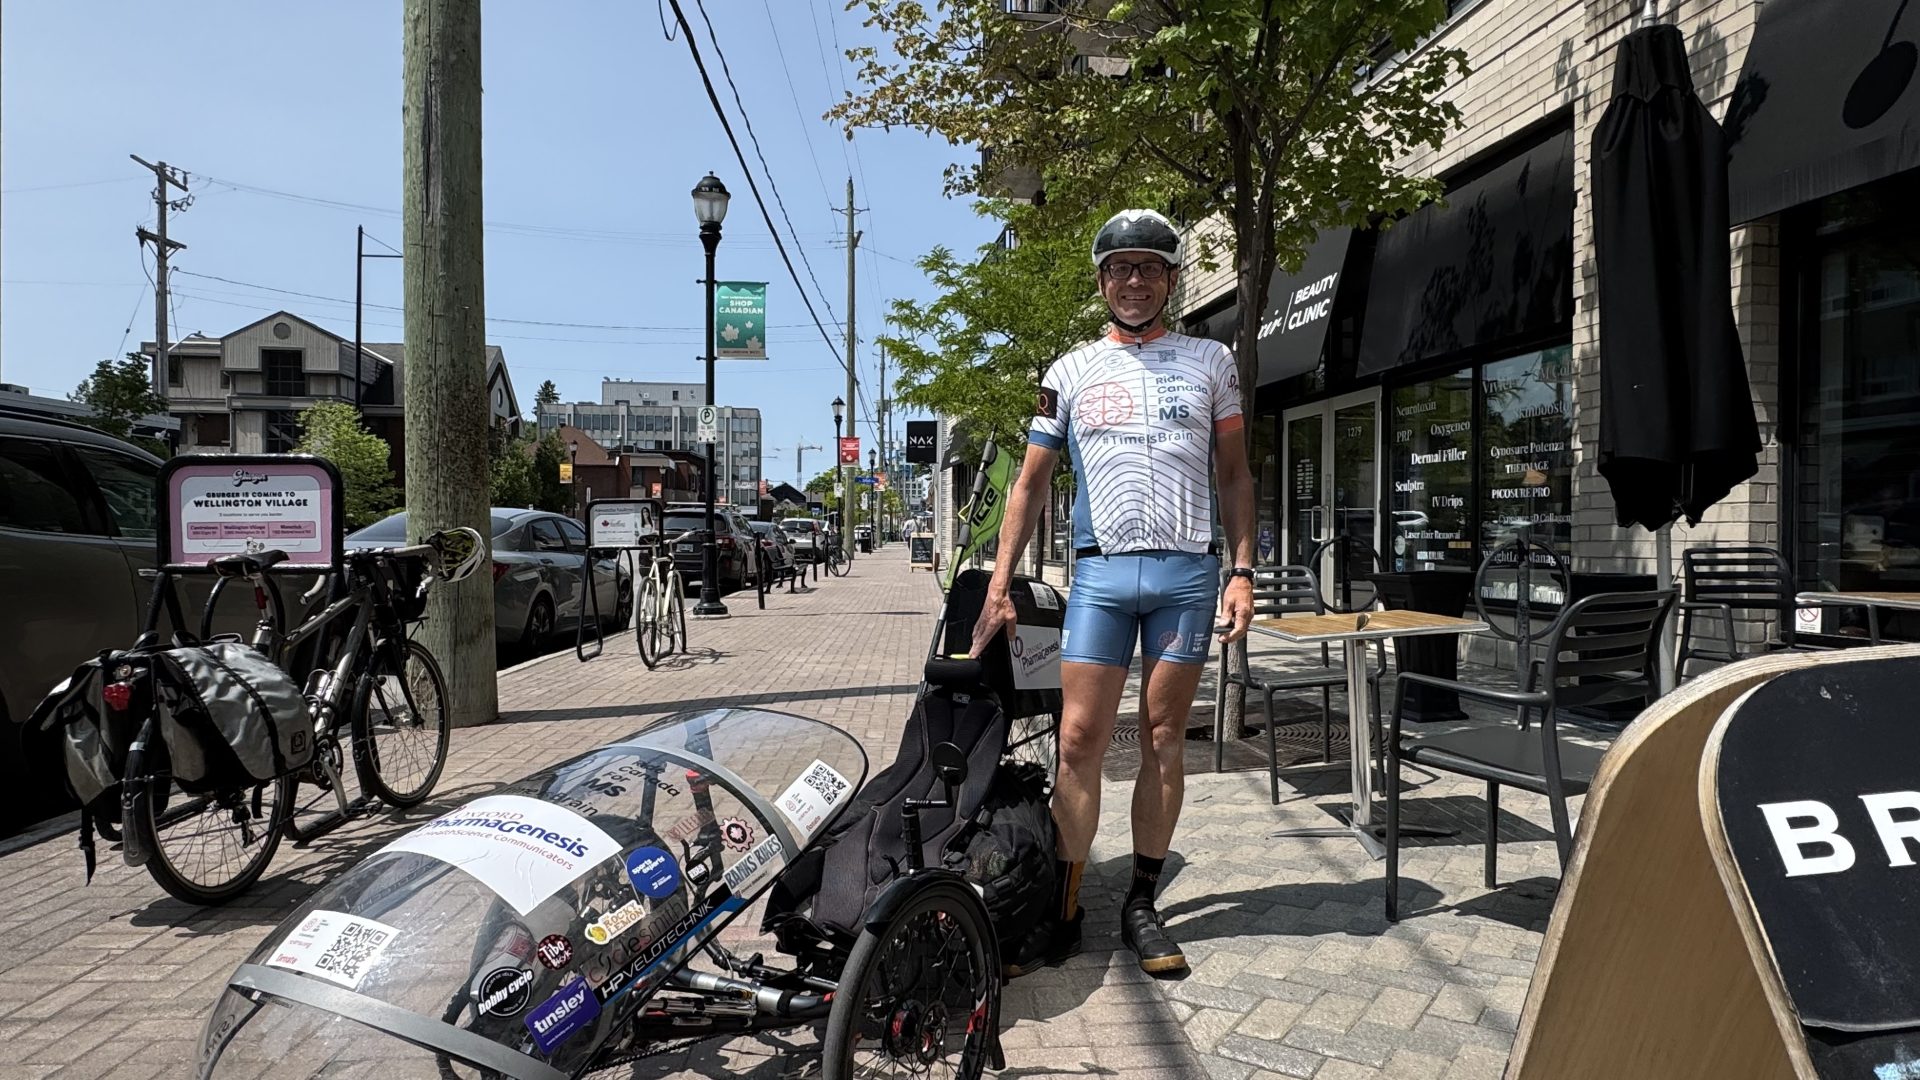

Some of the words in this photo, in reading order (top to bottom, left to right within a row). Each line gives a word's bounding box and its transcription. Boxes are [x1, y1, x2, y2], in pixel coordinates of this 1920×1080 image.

[1294, 272, 1338, 304] BEAUTY
[1288, 298, 1331, 330] CLINIC
[1155, 375, 1184, 385] Ride
[1156, 384, 1208, 395] Canada
[1157, 395, 1180, 405] For
[1159, 405, 1190, 421] MS
[909, 435, 934, 445] NAK
[1102, 430, 1193, 446] #TimeIsBrain
[1347, 426, 1362, 438] 1279
[1396, 429, 1413, 442] PRP
[1411, 449, 1442, 465] Dermal
[1443, 447, 1468, 462] Filler
[1490, 444, 1529, 459] Cynosure
[1530, 441, 1565, 454] Potenza
[1504, 460, 1549, 474] THERMAGE
[1395, 479, 1425, 493] Sculptra
[1491, 487, 1531, 499] PICOSURE
[1532, 486, 1550, 498] PRO
[193, 499, 262, 508] WELLINGTON
[265, 499, 308, 507] VILLAGE
[1432, 496, 1441, 508] IV
[1442, 494, 1464, 509] Drips
[1404, 530, 1421, 539] Laser
[1421, 529, 1433, 539] Hair
[1434, 530, 1461, 539] Removal
[601, 771, 631, 783] For
[617, 765, 681, 797] Canada
[581, 778, 627, 797] MS
[453, 807, 525, 820] OXFORD
[431, 816, 590, 859] PharmaGenesis
[1757, 791, 1920, 878] BR
[493, 833, 575, 871] Communicators
[632, 858, 652, 875] sports
[724, 854, 758, 890] BANKS
[753, 836, 782, 866] BIKES
[603, 902, 636, 928] ROCKY
[608, 908, 644, 935] LEMON
[588, 898, 684, 984] cyclesmith
[601, 973, 625, 1000] HP
[622, 898, 715, 979] VELOTECHNIK
[538, 940, 565, 961] Tibo
[478, 986, 508, 1016] hobby
[508, 969, 533, 994] cycle
[533, 989, 585, 1034] tinsley
